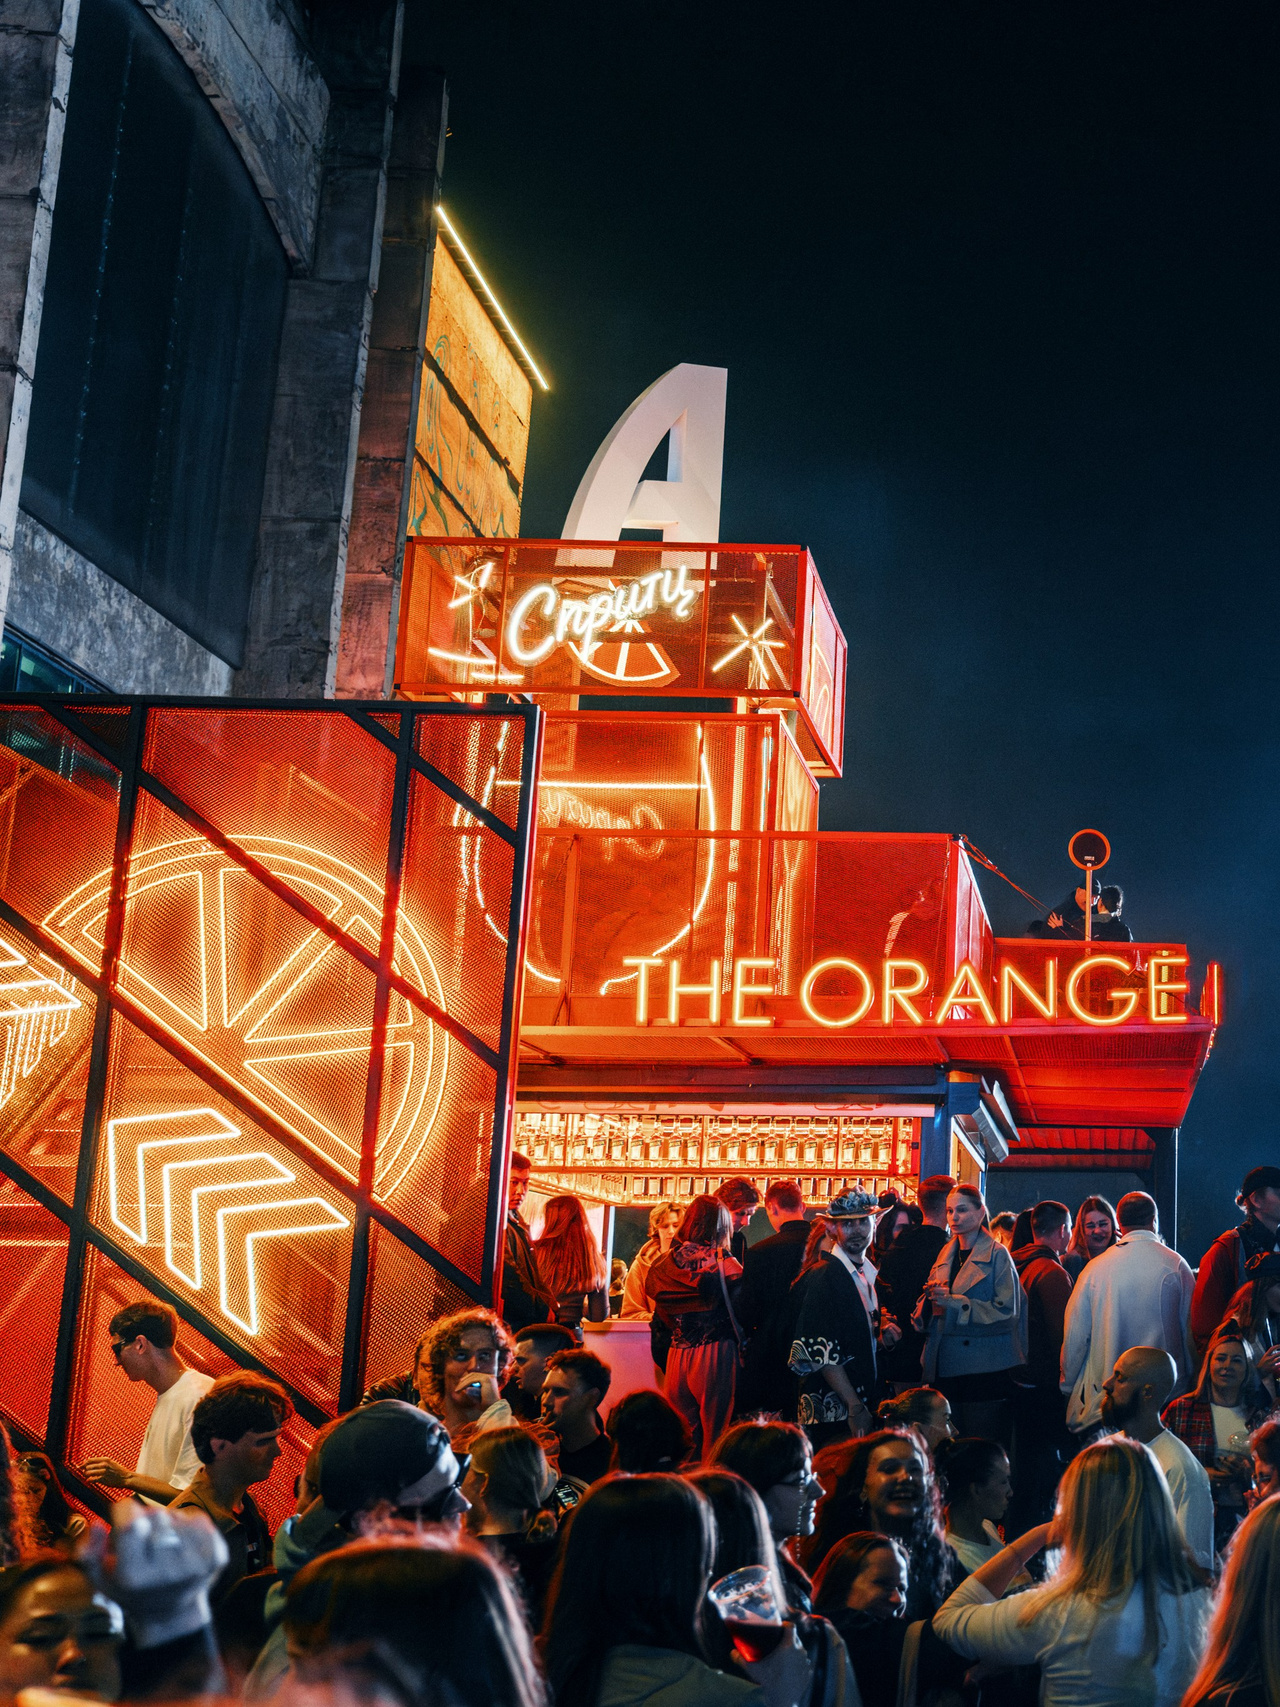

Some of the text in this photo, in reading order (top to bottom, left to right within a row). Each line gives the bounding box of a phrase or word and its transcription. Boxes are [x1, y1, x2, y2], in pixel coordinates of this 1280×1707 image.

[508, 565, 696, 663] Спритц
[623, 956, 1188, 1027] THE ORANGE
